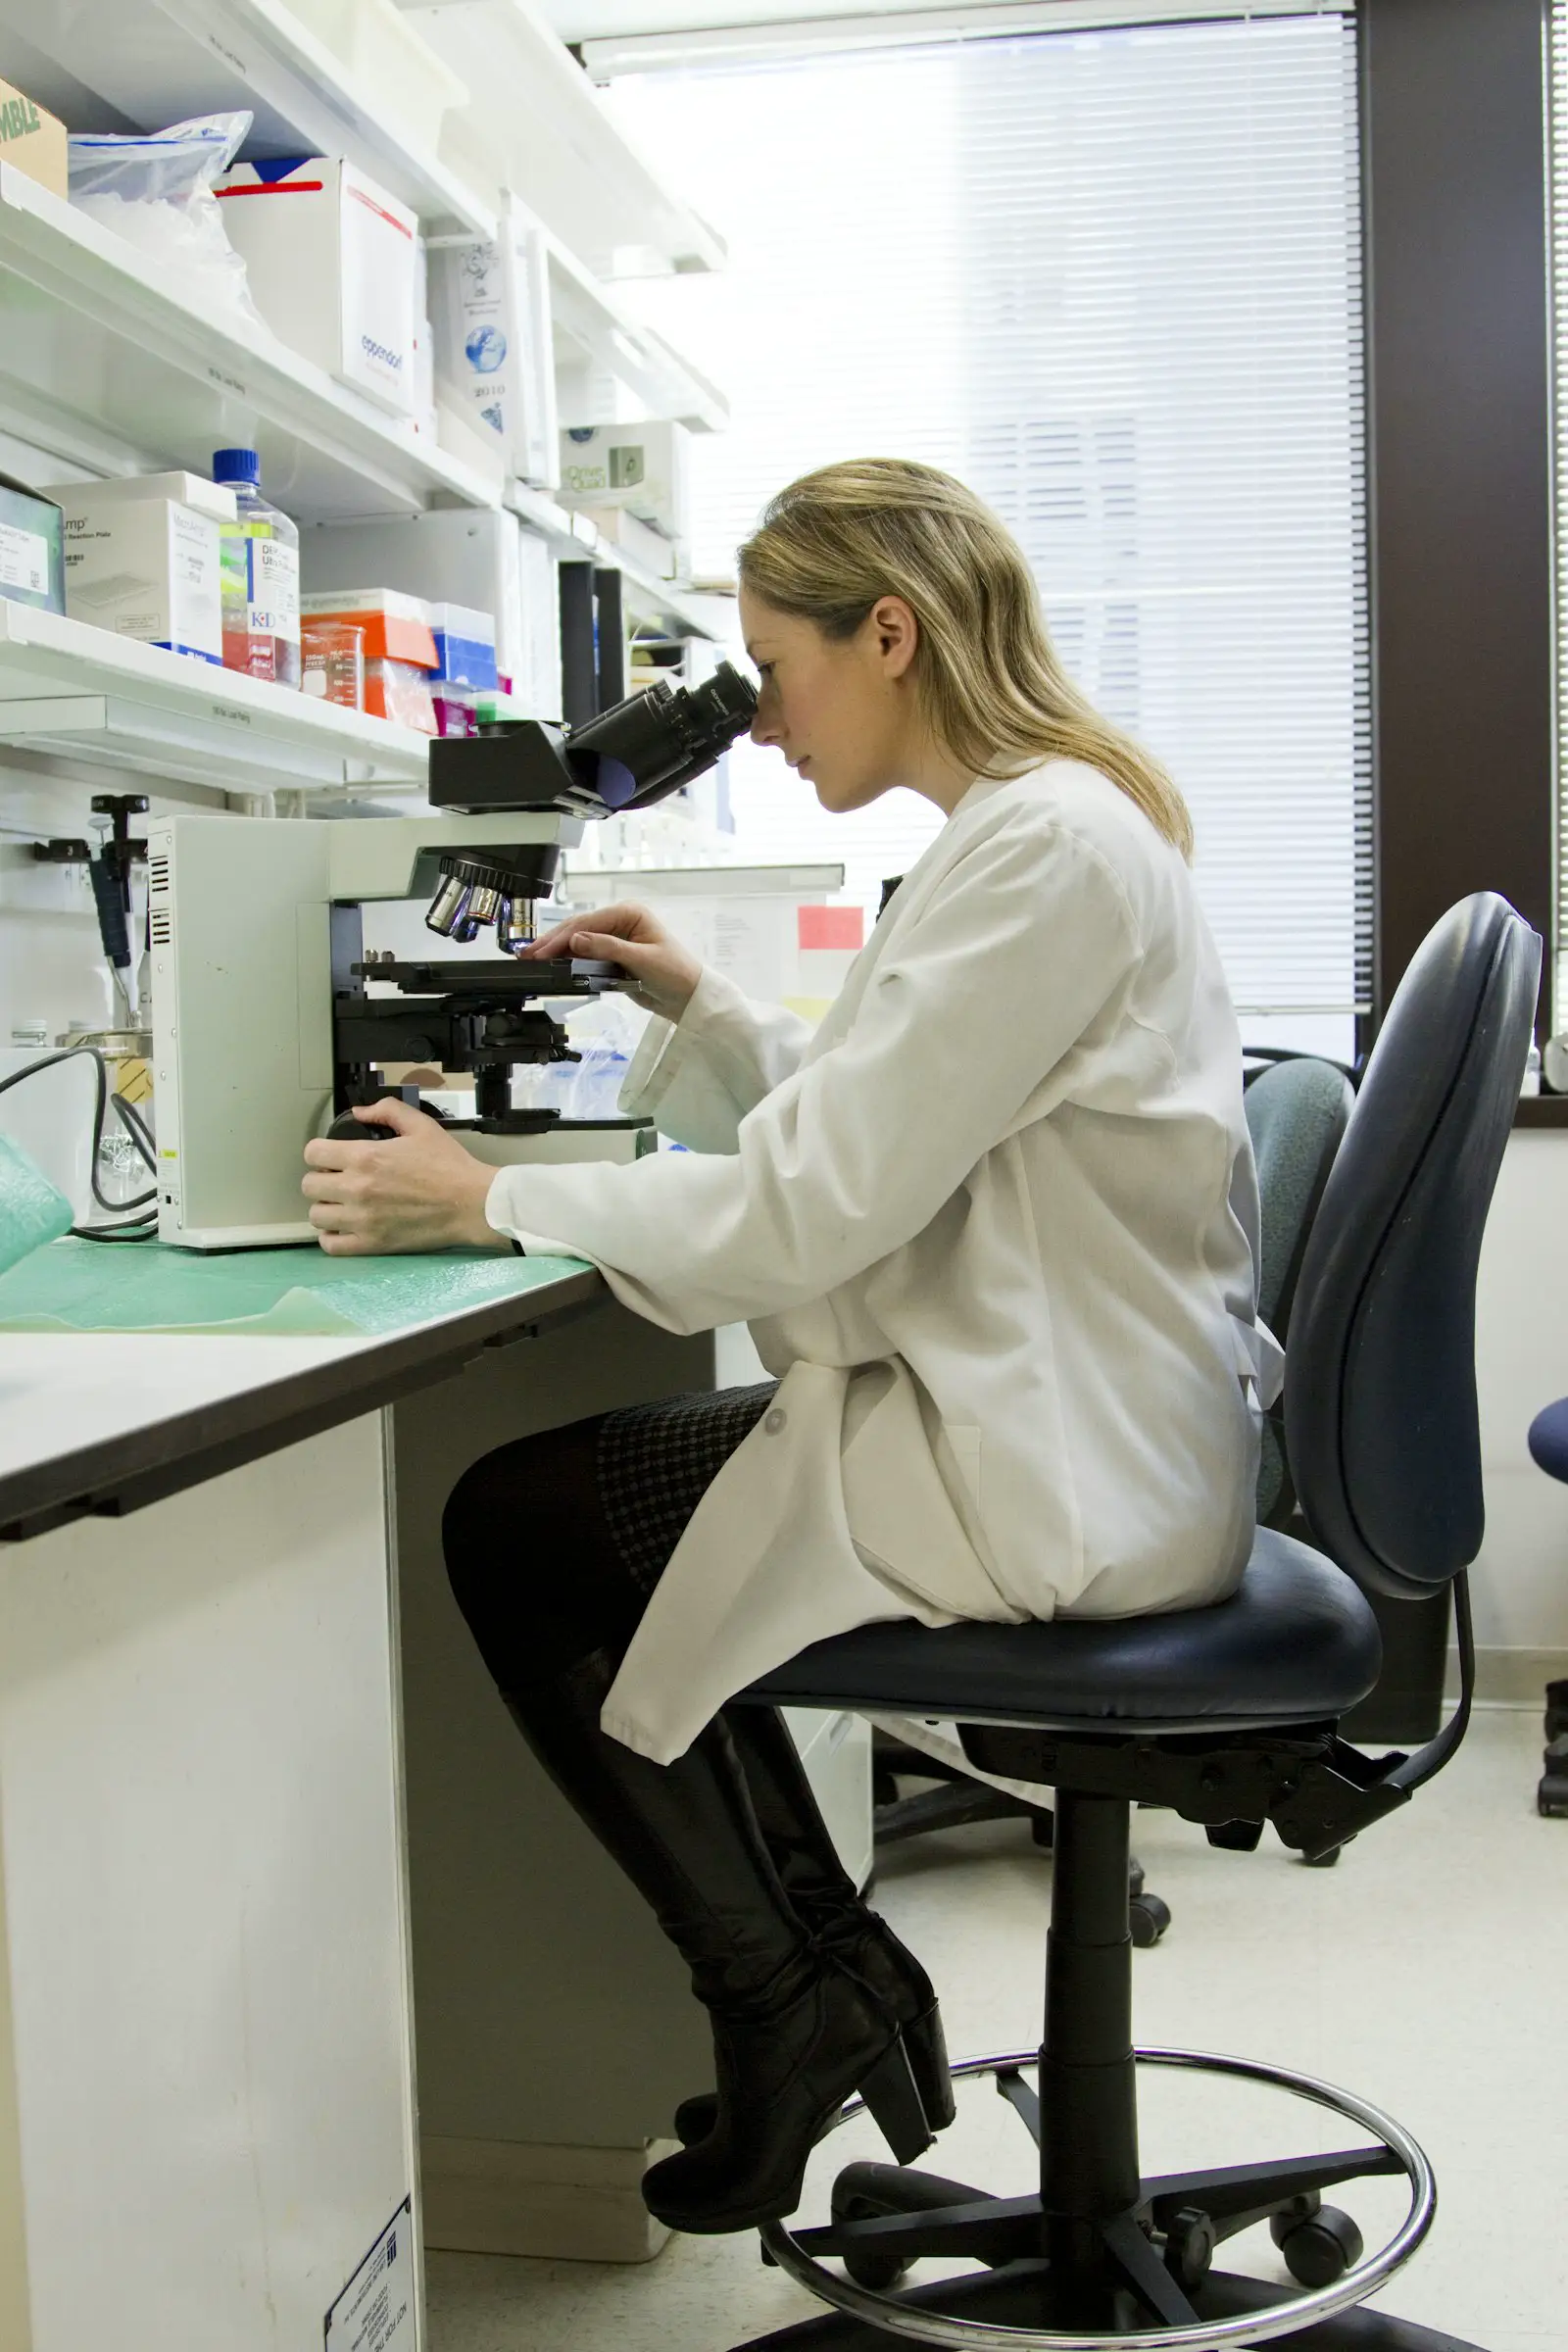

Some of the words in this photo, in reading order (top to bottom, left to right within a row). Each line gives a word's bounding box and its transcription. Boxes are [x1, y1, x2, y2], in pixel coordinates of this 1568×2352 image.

[362, 334, 403, 370] eppendorf
[67, 845, 74, 857] 3
[396, 2300, 407, 2326] NOT
[385, 2318, 396, 2342] FOR
